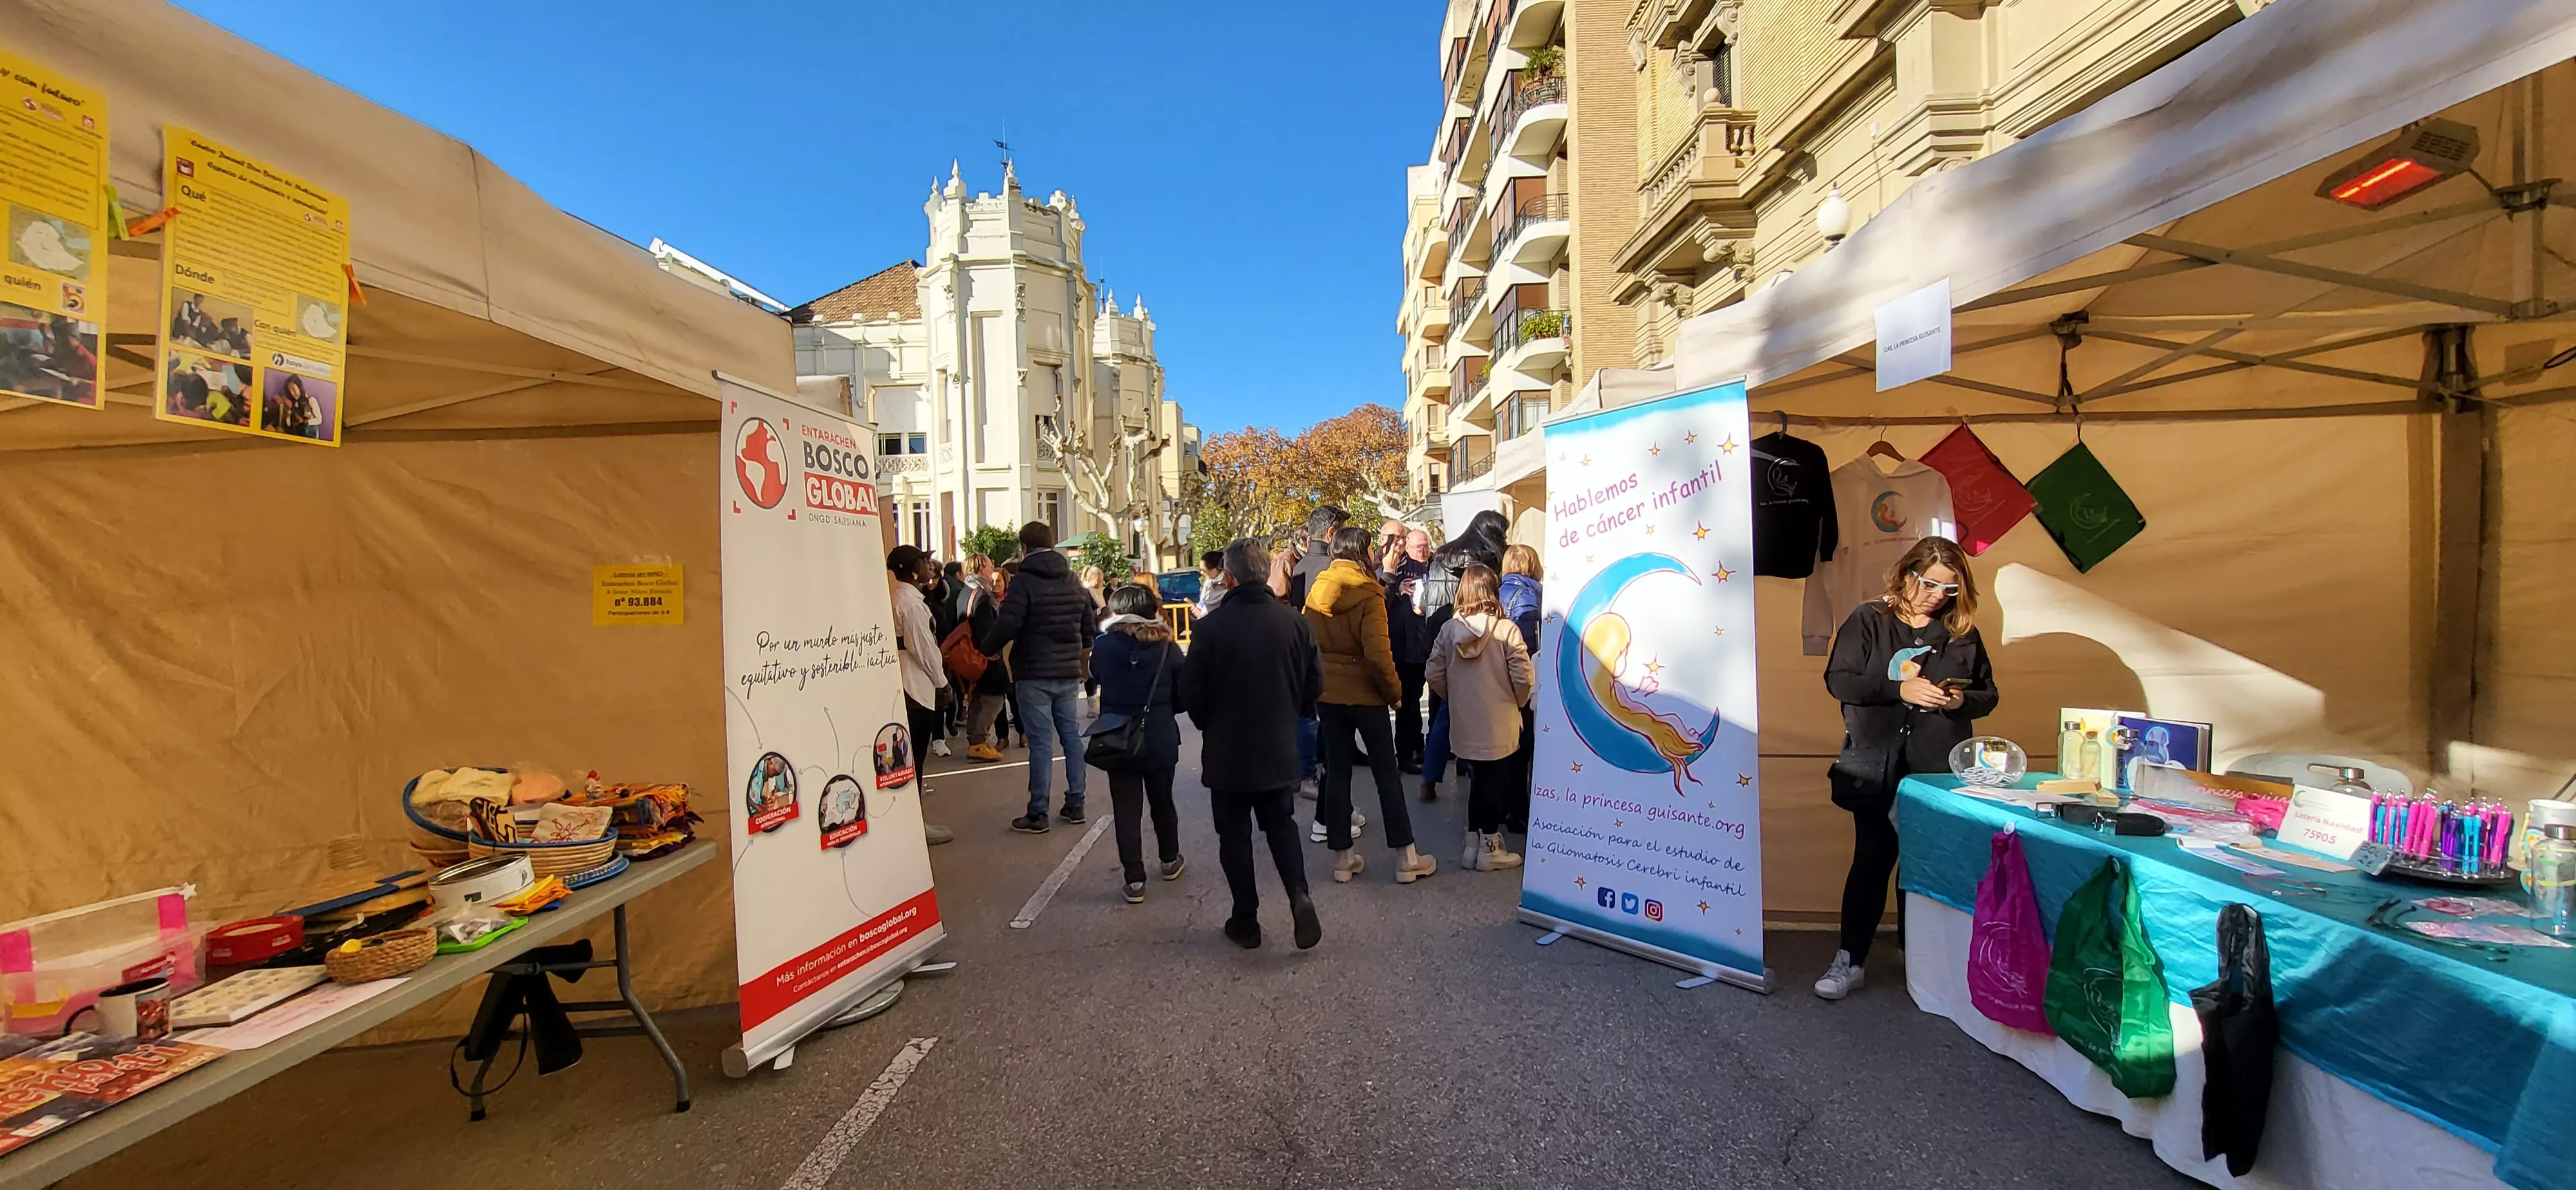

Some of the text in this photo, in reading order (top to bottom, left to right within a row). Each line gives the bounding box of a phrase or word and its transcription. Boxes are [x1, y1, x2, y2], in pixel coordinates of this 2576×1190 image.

[181, 185, 207, 202] Qué
[4, 274, 41, 291] quién
[175, 264, 215, 285] Dónde
[802, 424, 857, 449] ENTARACHEN
[802, 440, 869, 480] BOSCO
[806, 477, 878, 513] GLOBAL
[1553, 472, 1638, 523] Hablemos
[1559, 459, 1723, 548] de cáncer infantil
[809, 513, 831, 524] ONGD
[756, 630, 780, 656] Por
[784, 639, 800, 652] un
[804, 625, 838, 648] mundo
[858, 623, 887, 656] justo,
[741, 659, 797, 700] equitativo
[799, 667, 809, 692] y
[755, 806, 791, 825] COOPERACIÓN
[1533, 784, 1745, 840] Izas, la princesa guisante.org
[2322, 818, 2363, 834] Navidad
[829, 824, 858, 840] EDUCACIÓN
[1532, 817, 1745, 871] Asociación para el estudio de
[2303, 828, 2338, 845] 75905
[1531, 838, 1747, 897] la Gliomatosis Cerebri infantil
[775, 906, 917, 987] Más información en boscoglobal.org
